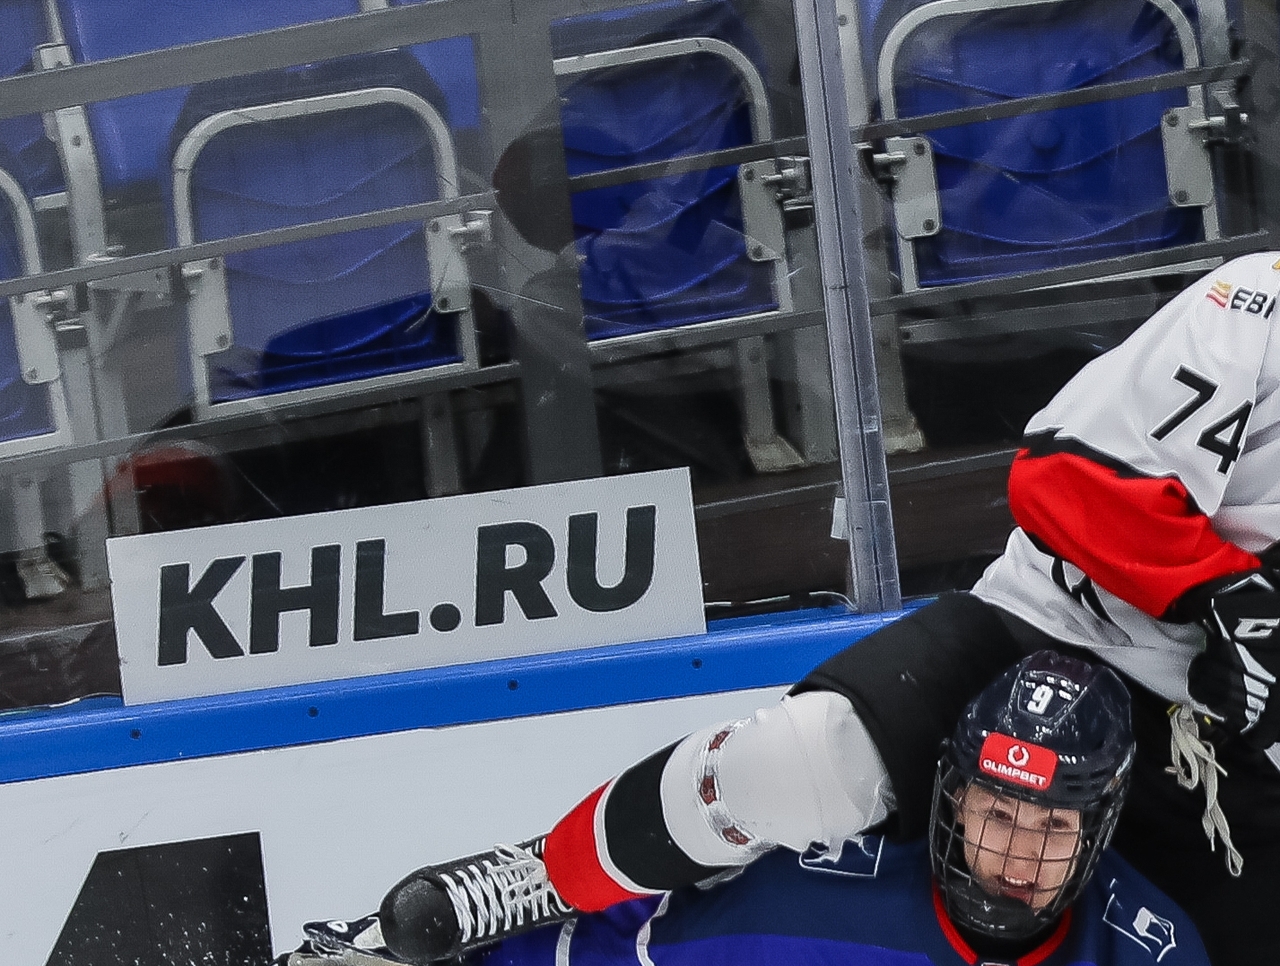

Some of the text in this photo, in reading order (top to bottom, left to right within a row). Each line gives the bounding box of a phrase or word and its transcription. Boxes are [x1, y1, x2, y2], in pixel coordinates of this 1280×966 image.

[1150, 364, 1255, 475] 74
[157, 504, 657, 667] KHL.RU
[1027, 684, 1054, 715] 9
[983, 759, 1047, 786] OLIMPBET
